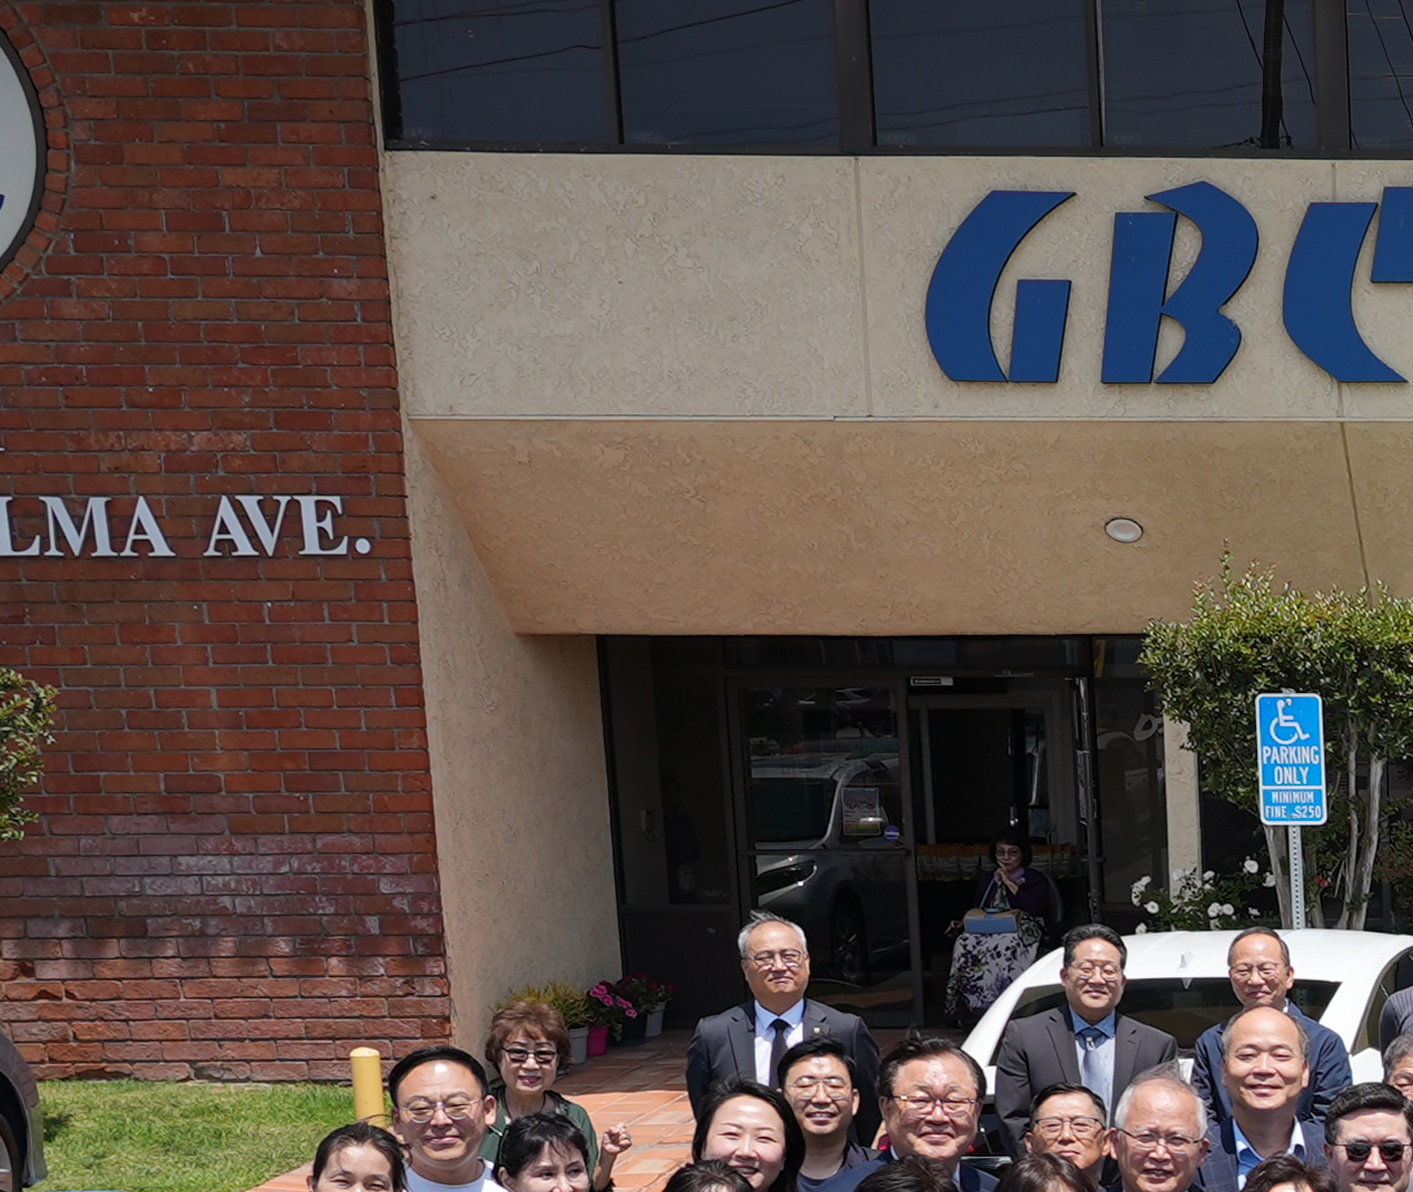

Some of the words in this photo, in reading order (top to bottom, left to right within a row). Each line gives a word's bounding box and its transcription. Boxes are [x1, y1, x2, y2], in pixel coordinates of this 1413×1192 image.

[0, 495, 176, 557] LMA
[203, 495, 372, 557] AVE.
[1262, 746, 1320, 765] PARKING
[1274, 766, 1310, 785] ONLY
[1271, 791, 1315, 804] MINIMUM
[1265, 805, 1287, 819] FINE
[1294, 805, 1322, 819] $250
